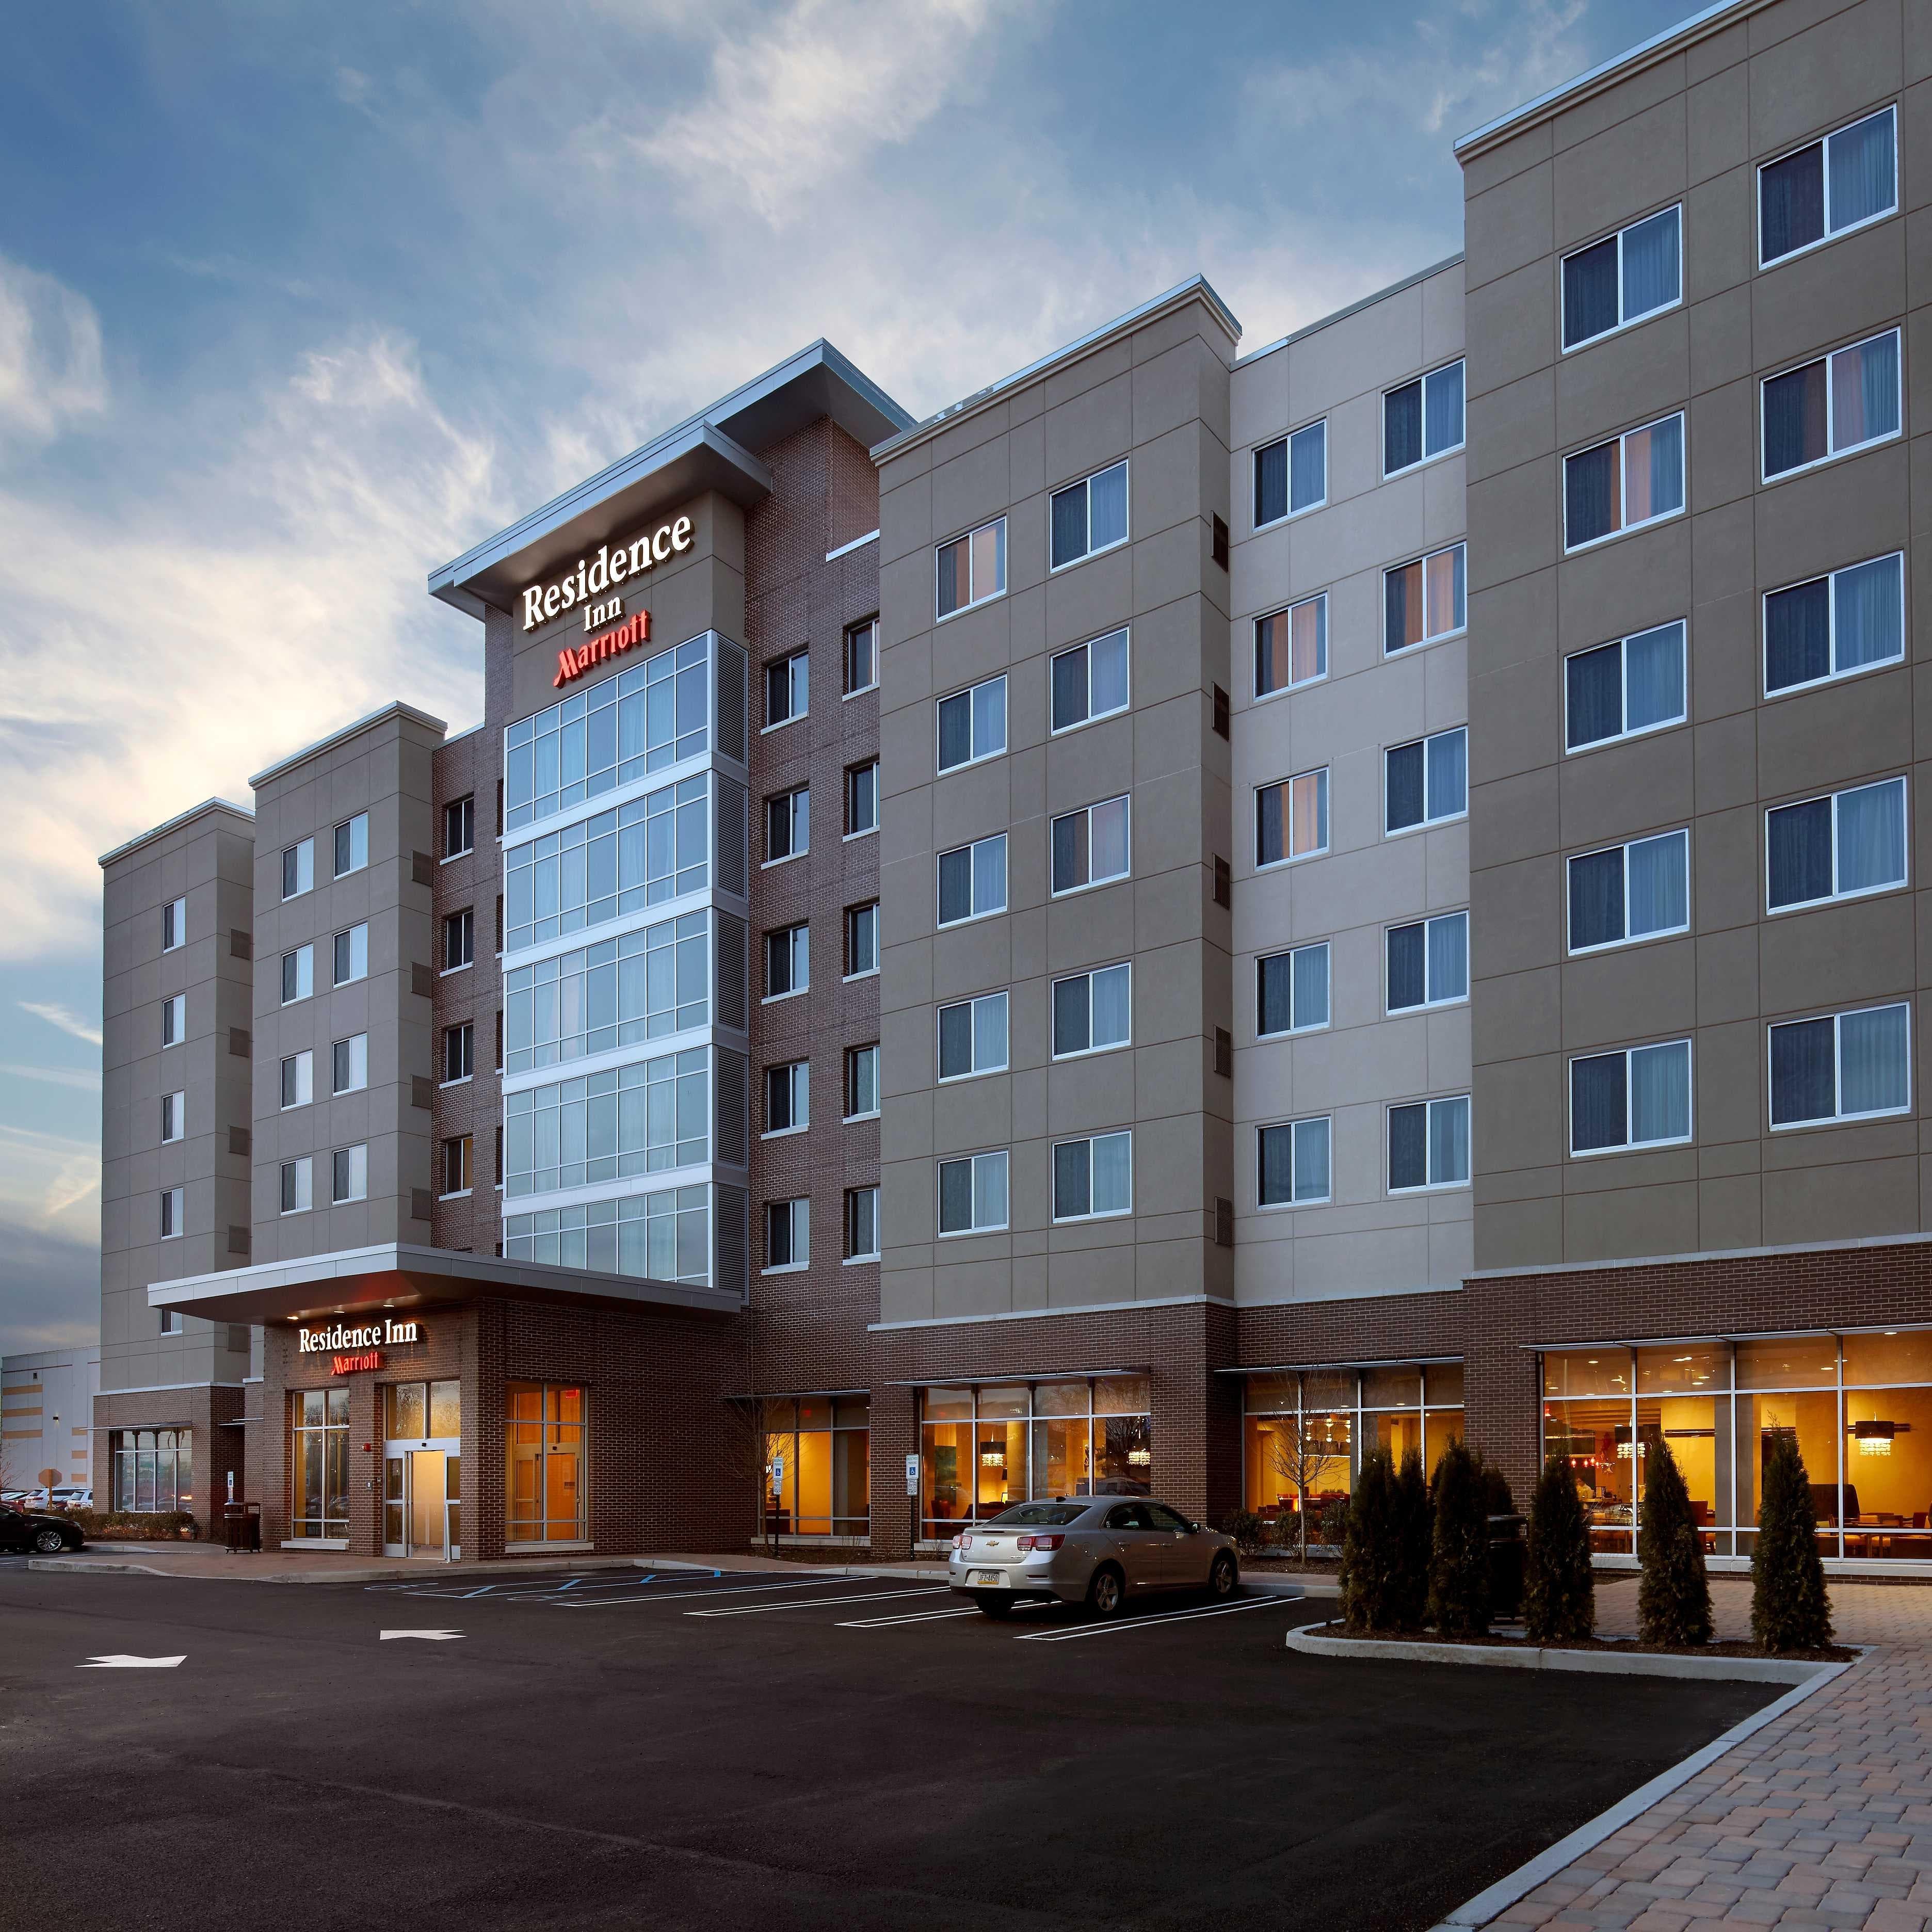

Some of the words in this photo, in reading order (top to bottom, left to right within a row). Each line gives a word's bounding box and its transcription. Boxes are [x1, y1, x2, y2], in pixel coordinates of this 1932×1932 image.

[523, 516, 691, 631] Residence
[584, 597, 622, 631] Inn
[553, 609, 651, 687] Marriott
[299, 1324, 381, 1353] Residence
[384, 1319, 417, 1344] Inn
[330, 1351, 378, 1376] Marriott
